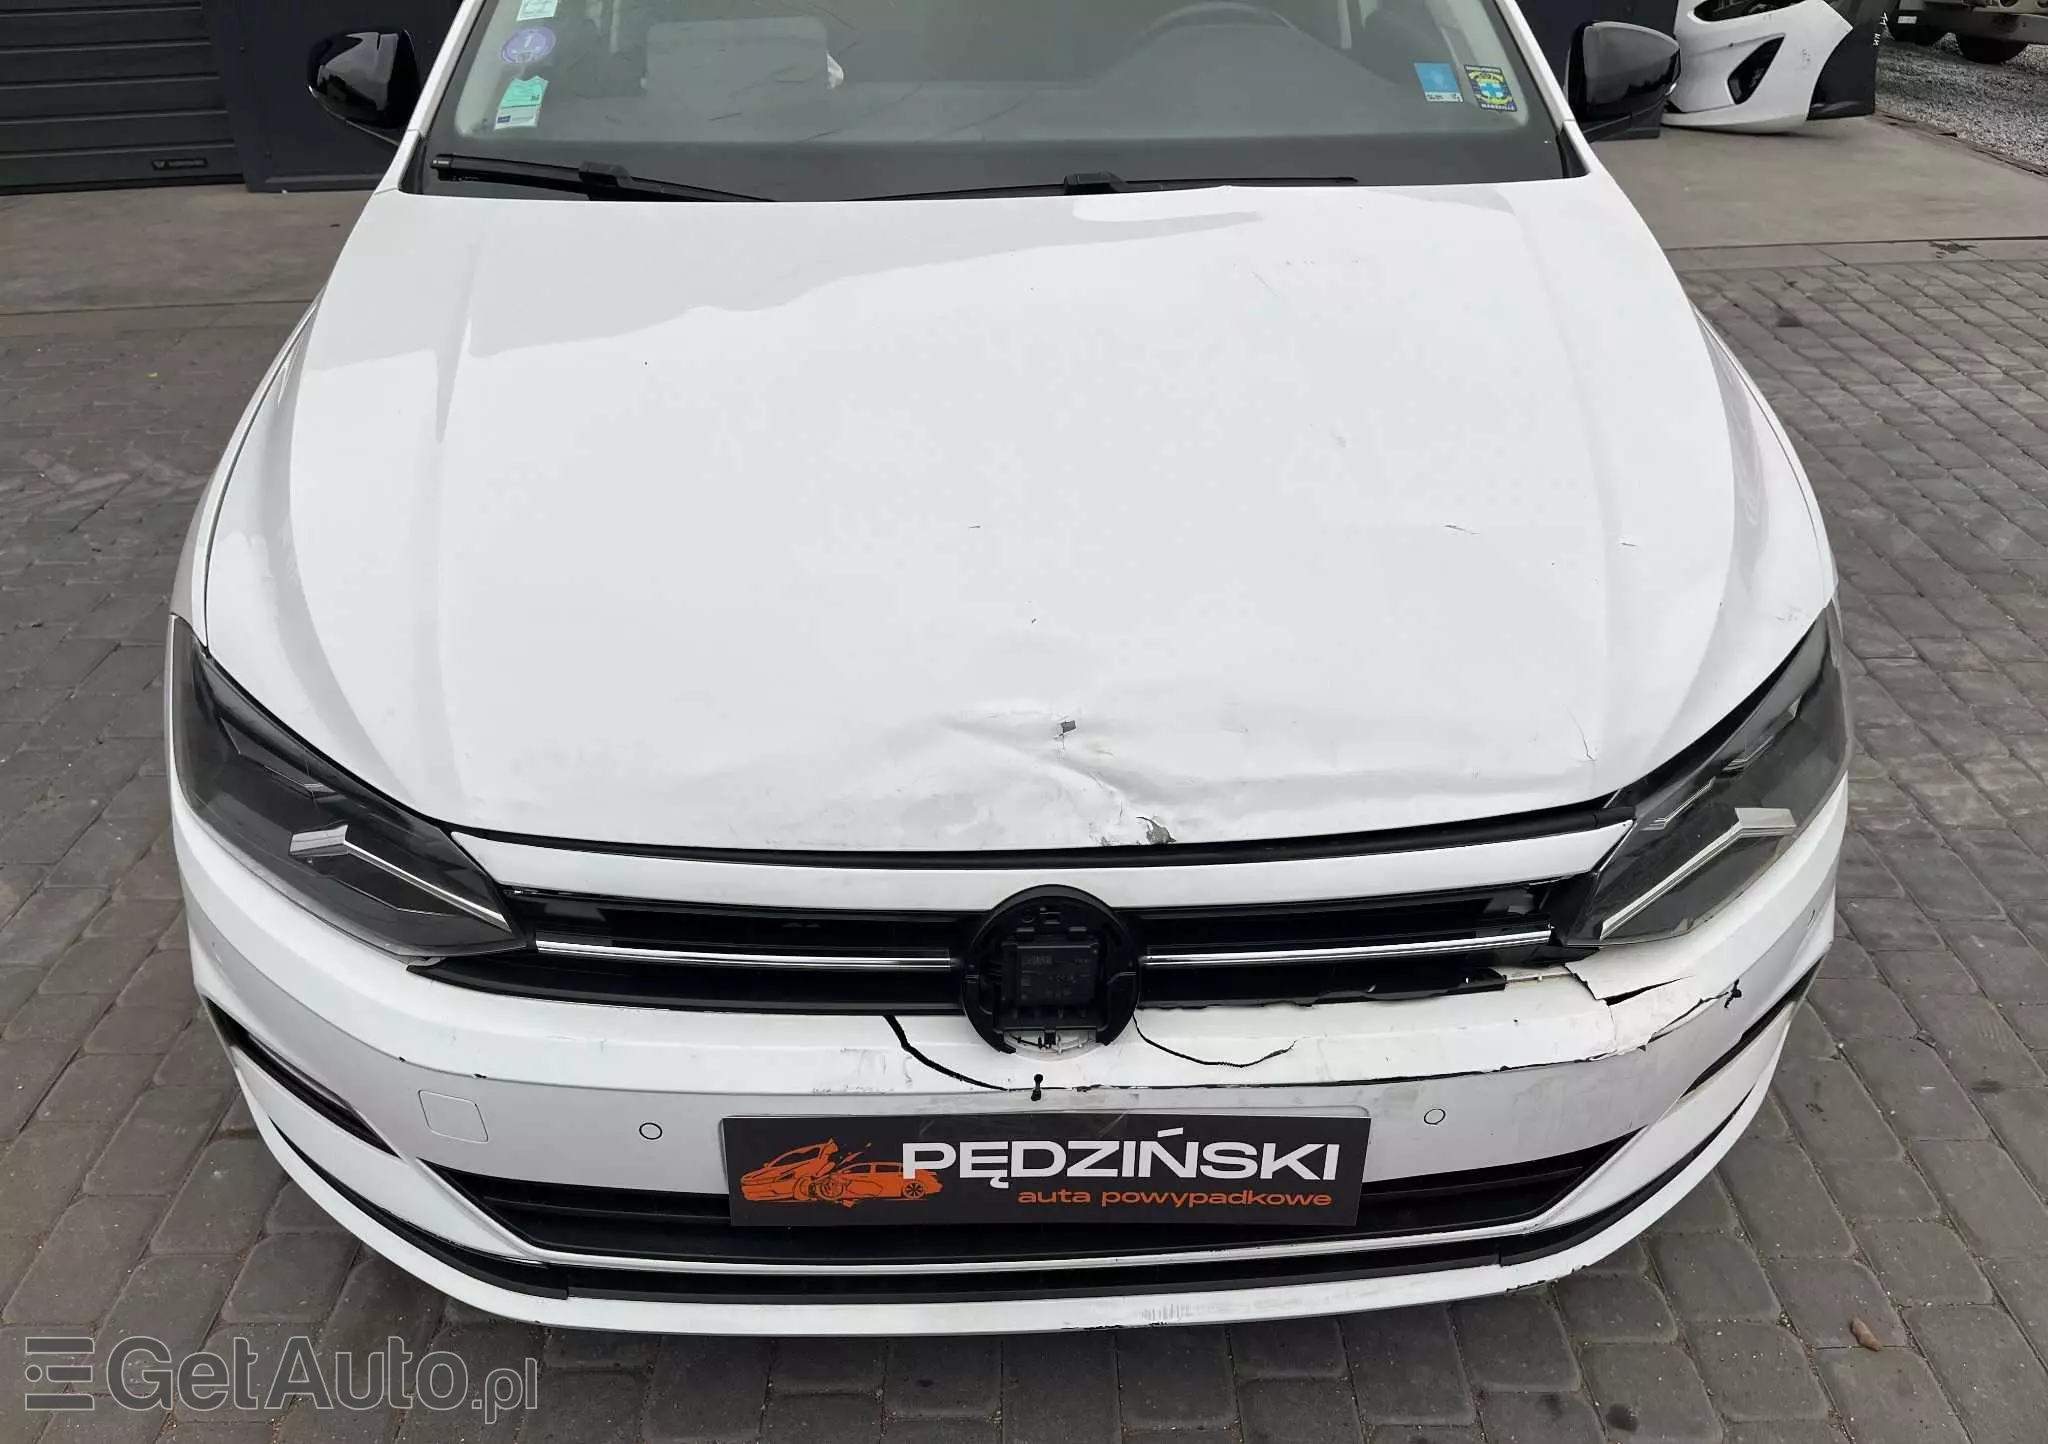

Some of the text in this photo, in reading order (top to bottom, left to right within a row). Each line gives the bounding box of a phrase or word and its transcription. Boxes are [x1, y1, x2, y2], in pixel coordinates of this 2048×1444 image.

[902, 1127, 1340, 1189] PĘDZIŃSKI
[1018, 1188, 1333, 1208] auta powypadkowe
